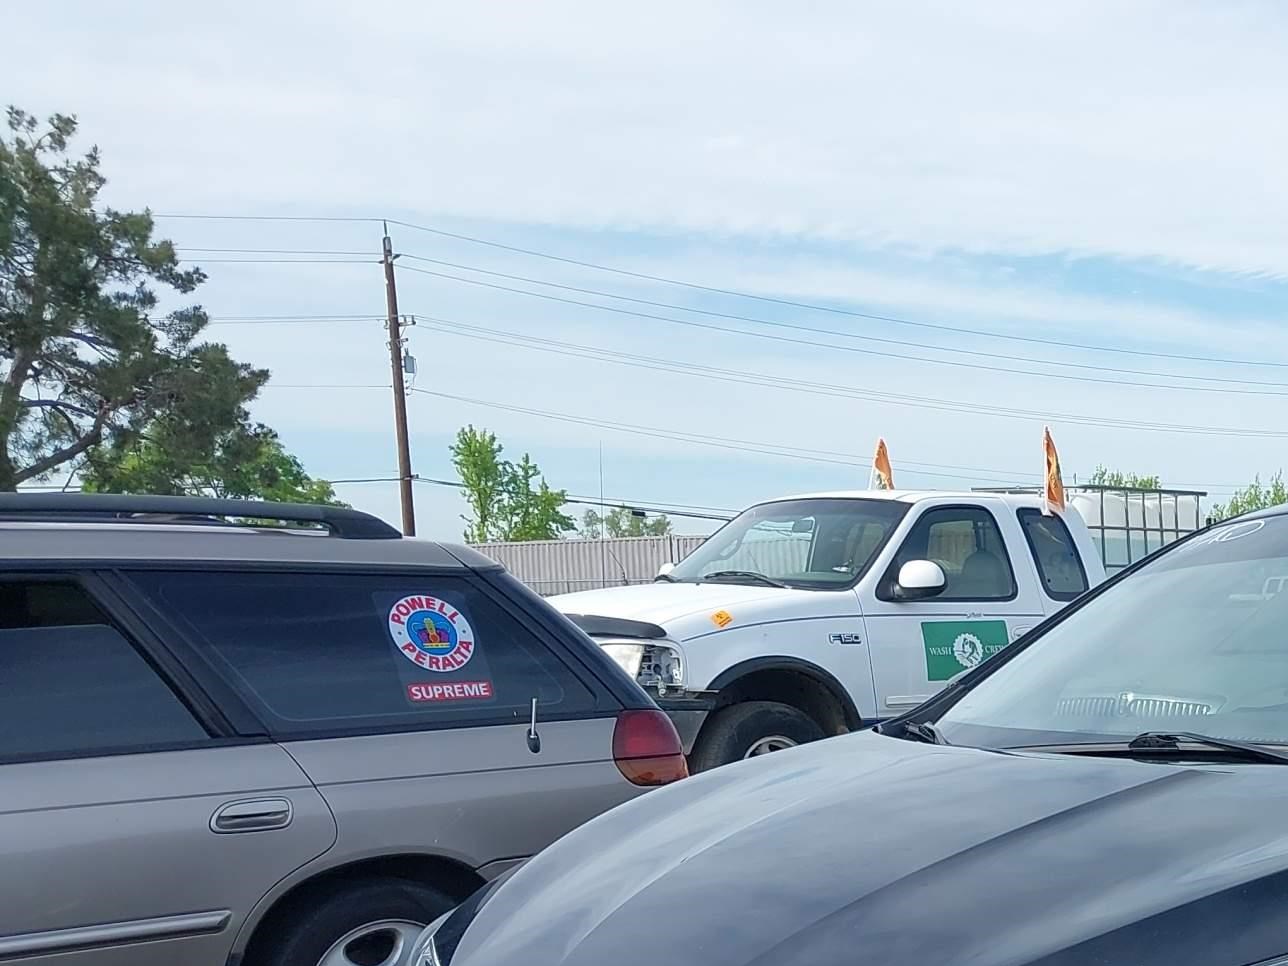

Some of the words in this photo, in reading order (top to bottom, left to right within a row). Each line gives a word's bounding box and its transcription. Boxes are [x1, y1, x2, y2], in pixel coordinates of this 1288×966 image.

[390, 596, 460, 626] POWELL
[401, 639, 473, 671] PERALTA
[929, 646, 952, 656] WASH
[410, 683, 490, 700] SUPREME
